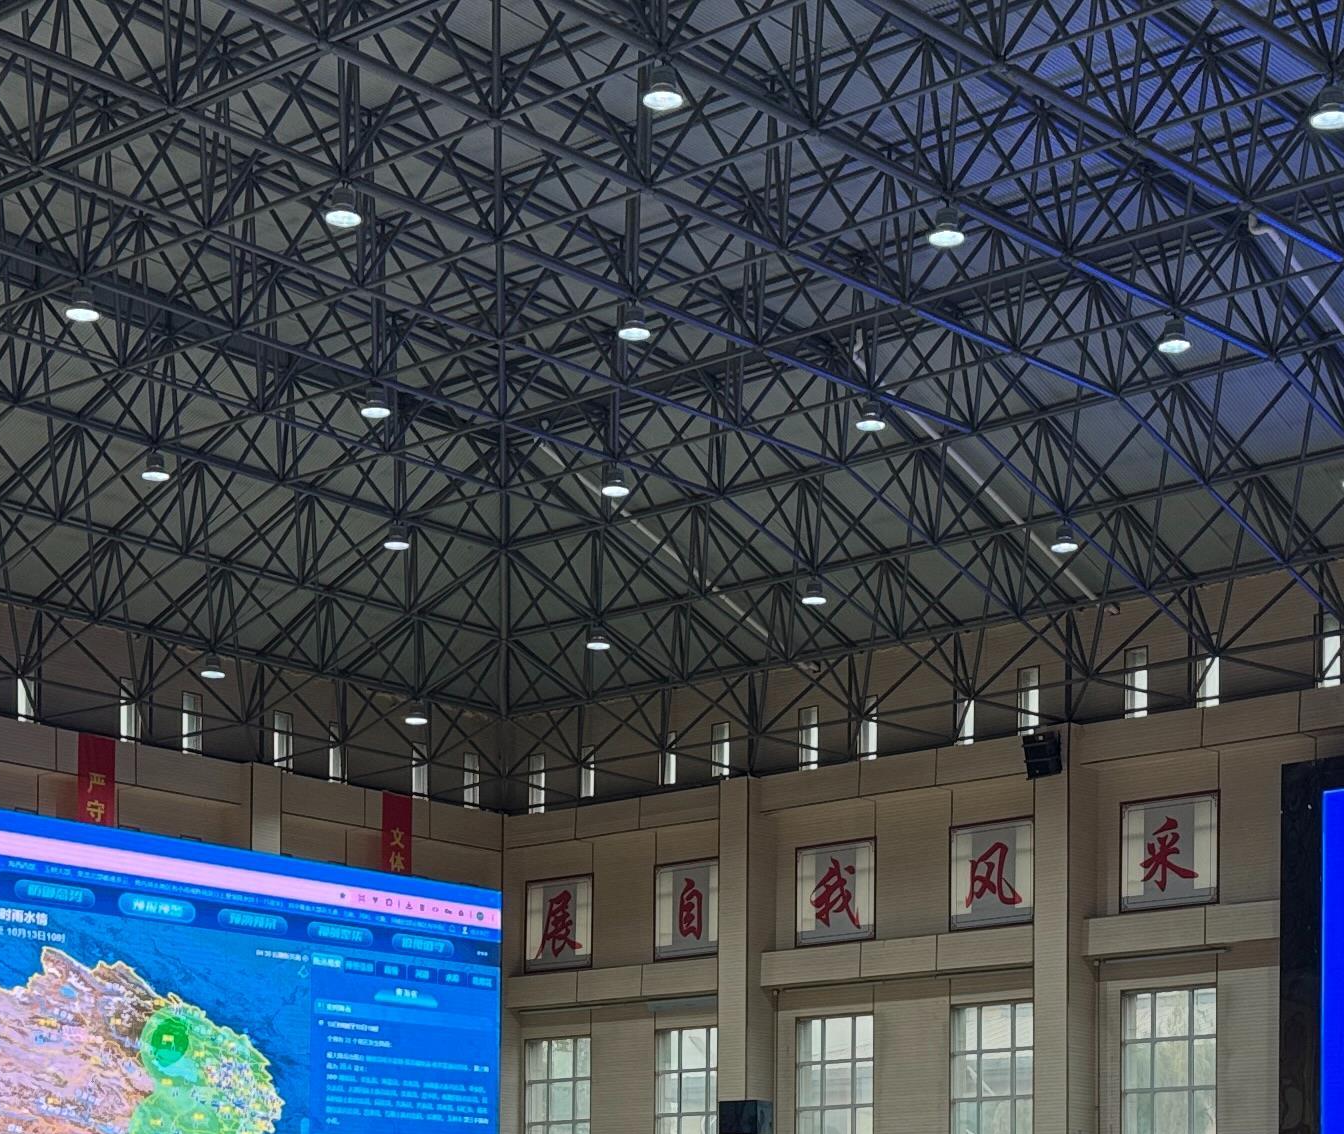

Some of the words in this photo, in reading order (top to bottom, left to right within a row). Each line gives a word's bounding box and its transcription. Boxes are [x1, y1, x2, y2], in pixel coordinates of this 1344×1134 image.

[86, 771, 107, 823] 严守
[534, 889, 584, 961] 展
[678, 877, 704, 941] 自
[809, 856, 863, 930] 我
[964, 841, 1024, 908] 风
[1139, 815, 1200, 892] 采
